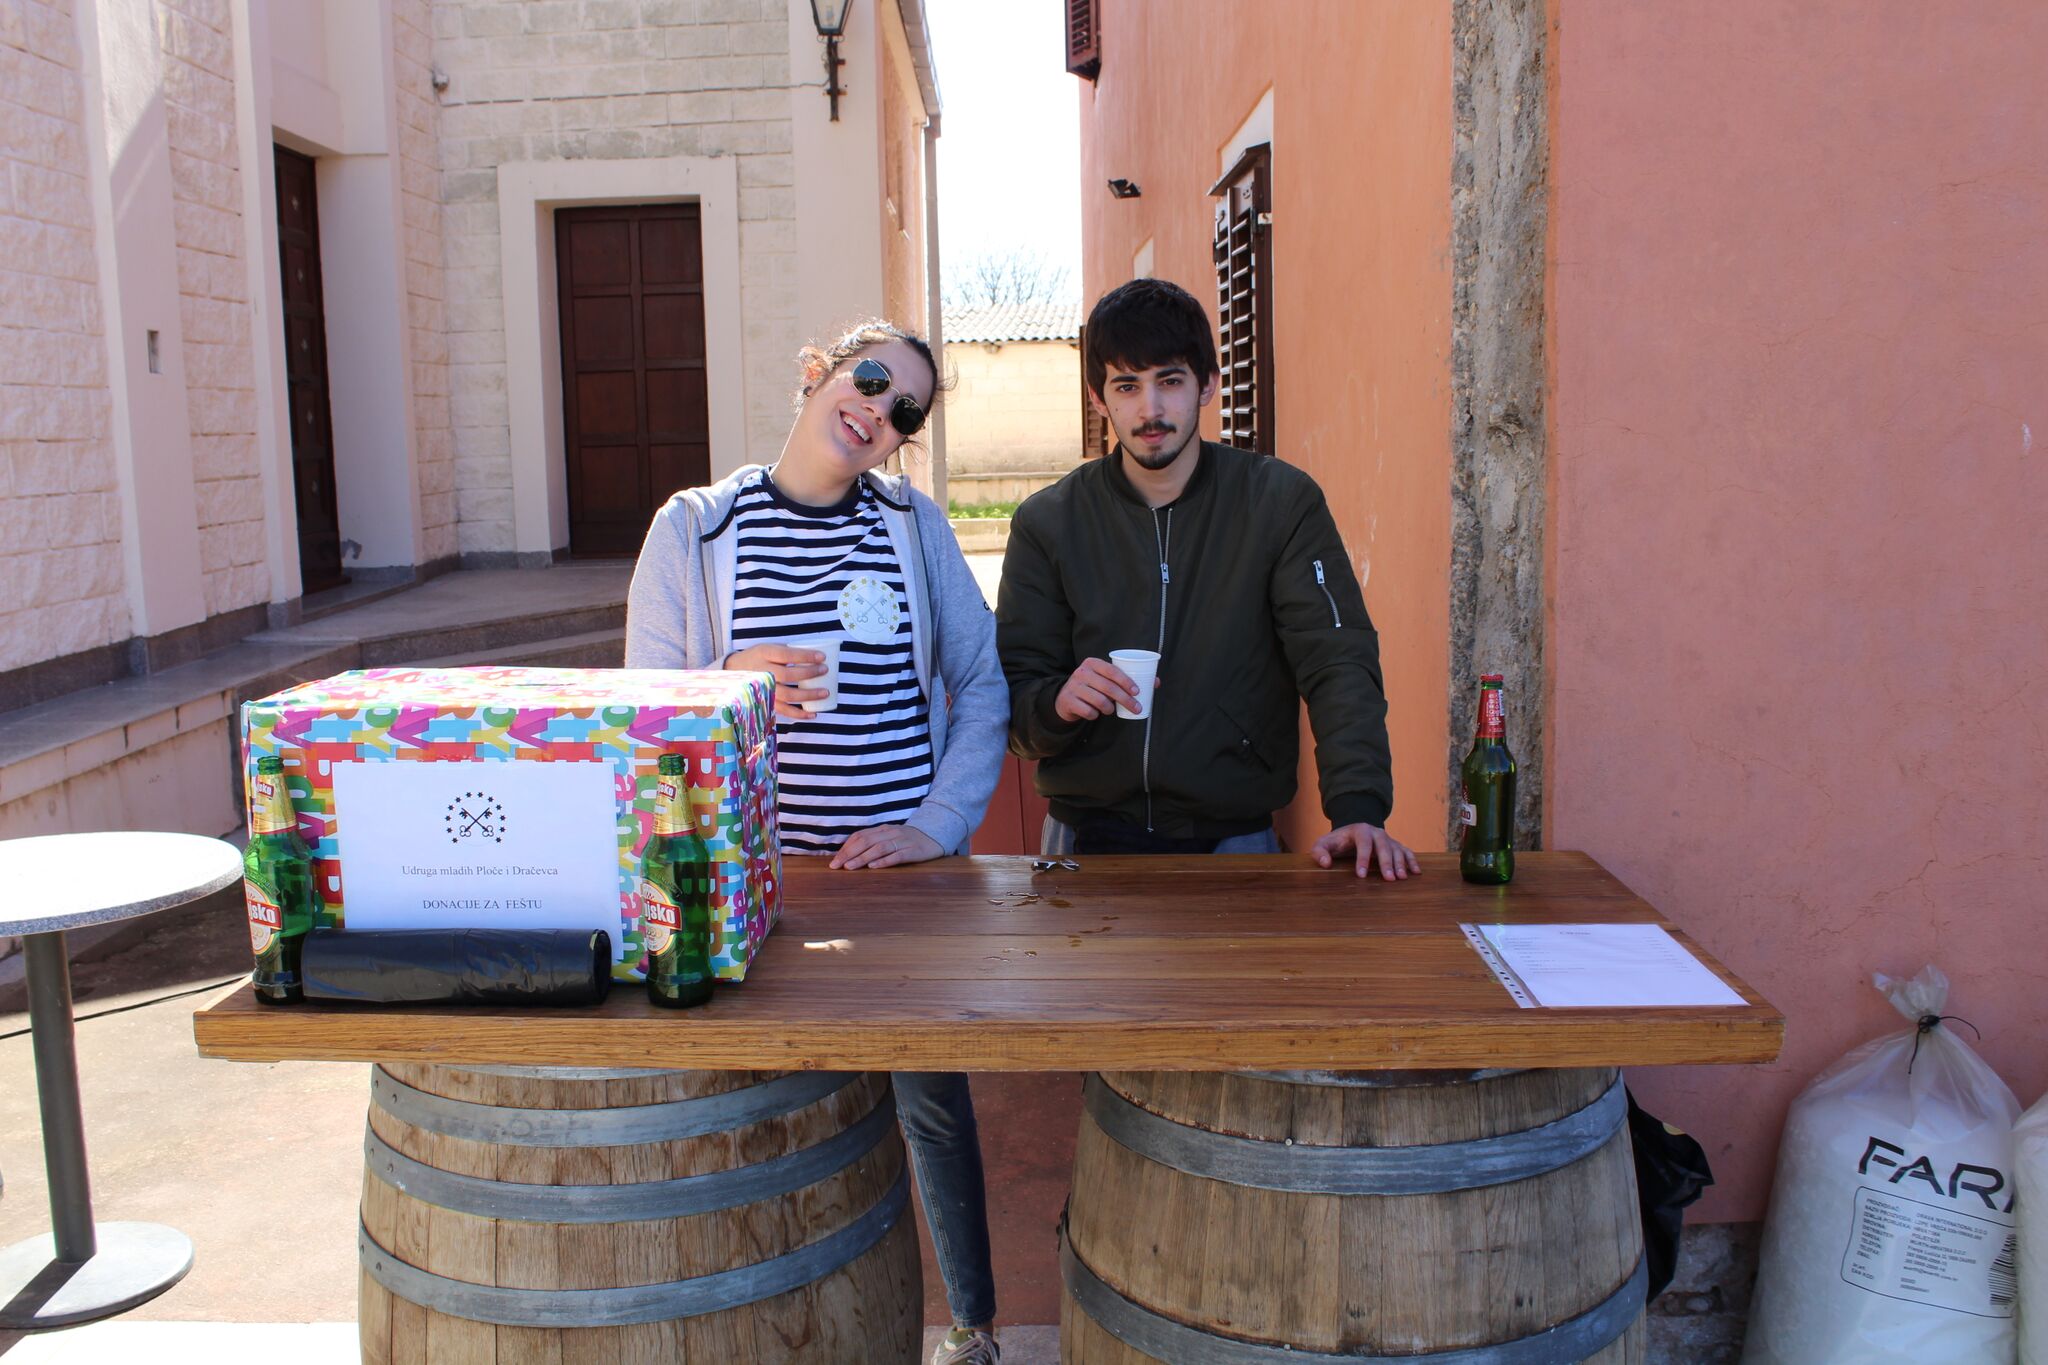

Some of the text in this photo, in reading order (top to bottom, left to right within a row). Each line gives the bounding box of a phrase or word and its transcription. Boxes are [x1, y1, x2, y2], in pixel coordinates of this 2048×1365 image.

[402, 866, 558, 877] Udruga mladih Ploče i Dračevca
[423, 898, 542, 909] DONACIJE ZA FEŠTU
[1858, 1136, 2014, 1214] FAR
